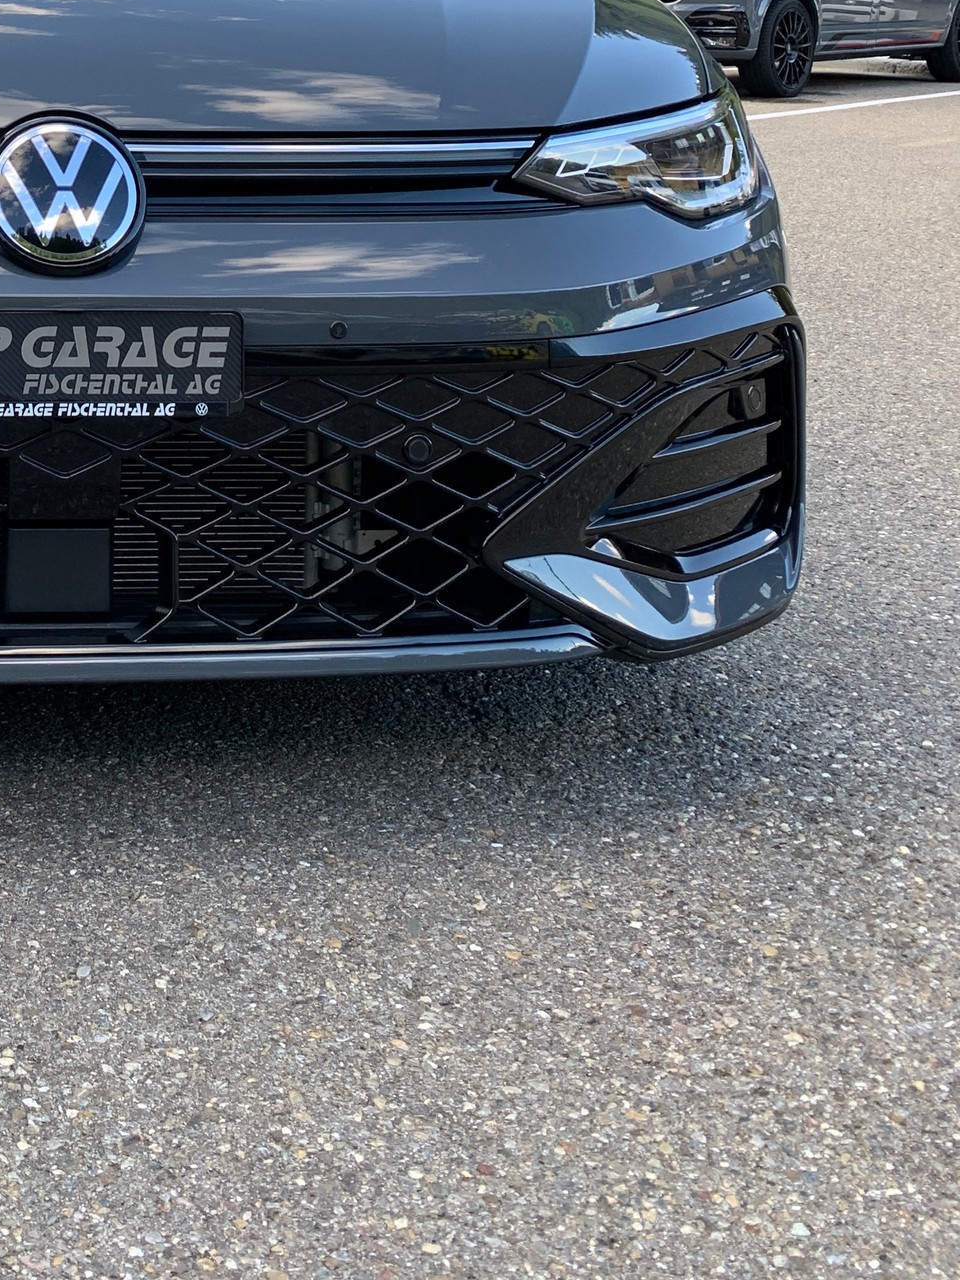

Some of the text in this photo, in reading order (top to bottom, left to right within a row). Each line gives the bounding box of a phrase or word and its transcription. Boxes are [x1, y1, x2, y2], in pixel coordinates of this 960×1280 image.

[21, 325, 231, 369] GARAGE
[22, 373, 222, 395] FISCHENTHAL AG
[57, 402, 150, 417] FISCHENTHAL
[153, 402, 176, 417] AG
